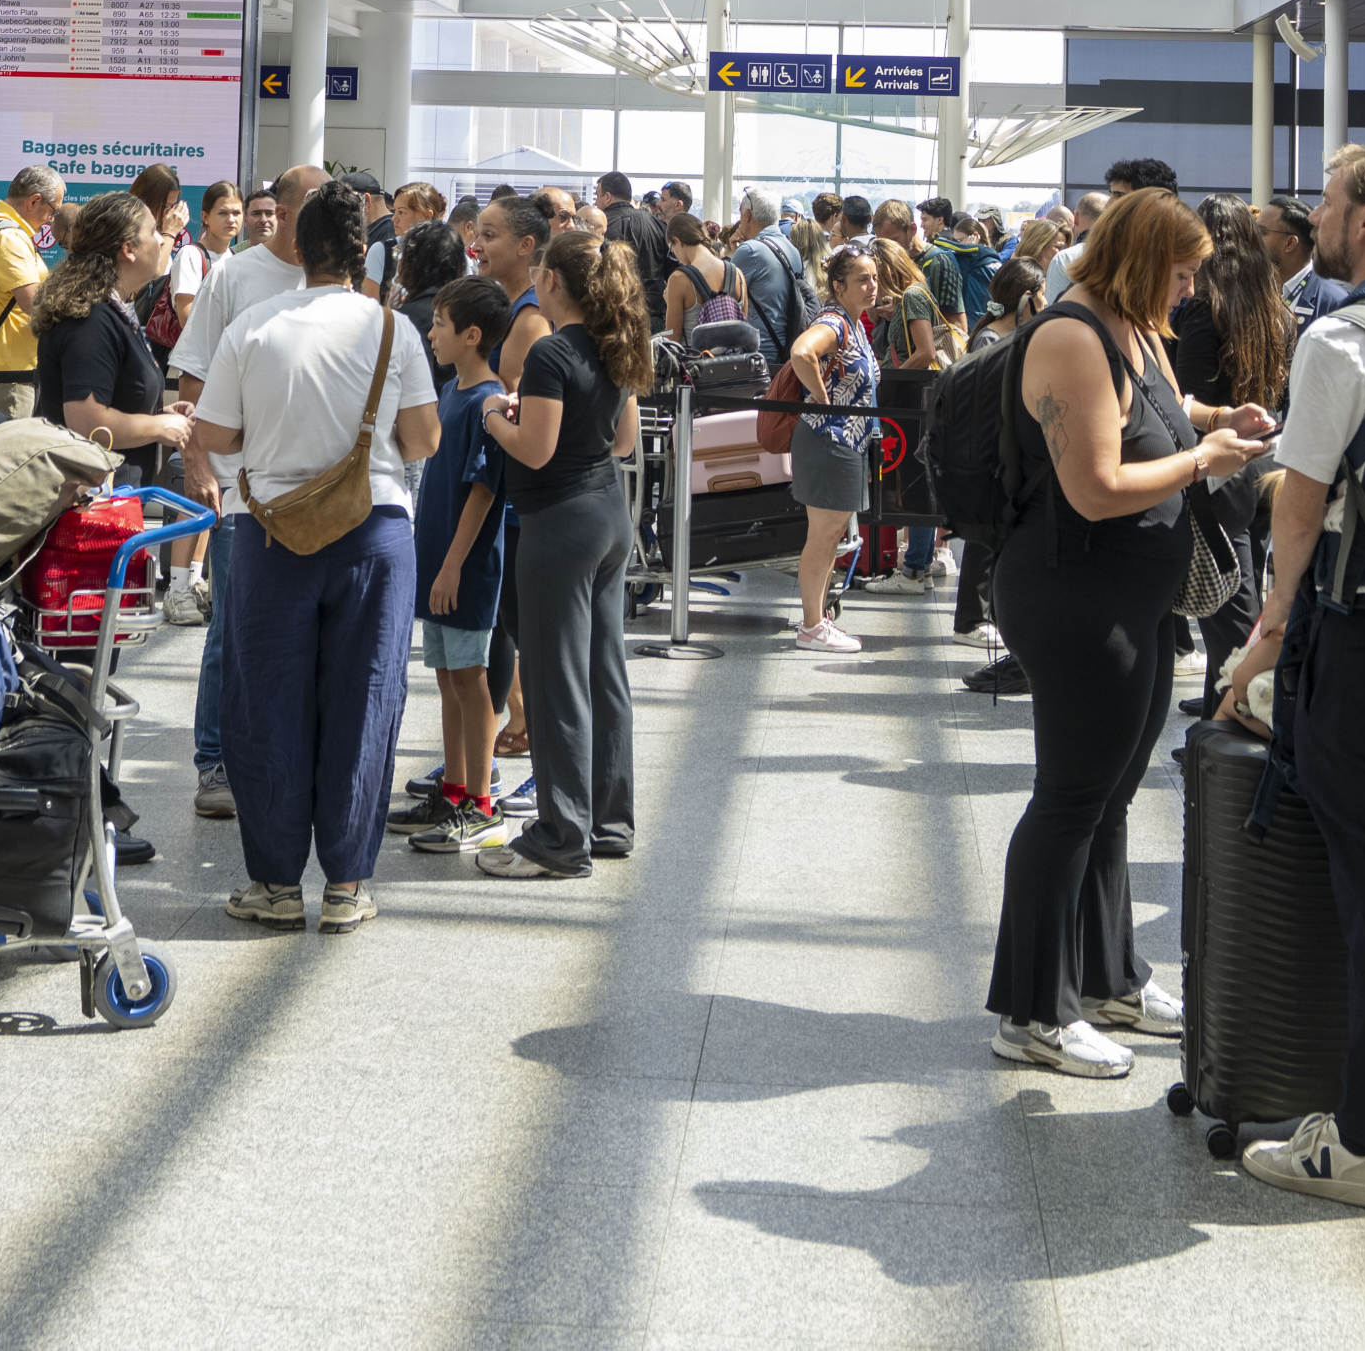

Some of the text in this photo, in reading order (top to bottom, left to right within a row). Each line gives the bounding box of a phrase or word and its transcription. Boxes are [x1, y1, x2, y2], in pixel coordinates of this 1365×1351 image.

[875, 66, 922, 76] Arrivées
[875, 80, 918, 89] Arrivals
[23, 141, 204, 157] Bagages sécuritaires
[48, 160, 86, 174] Safe
